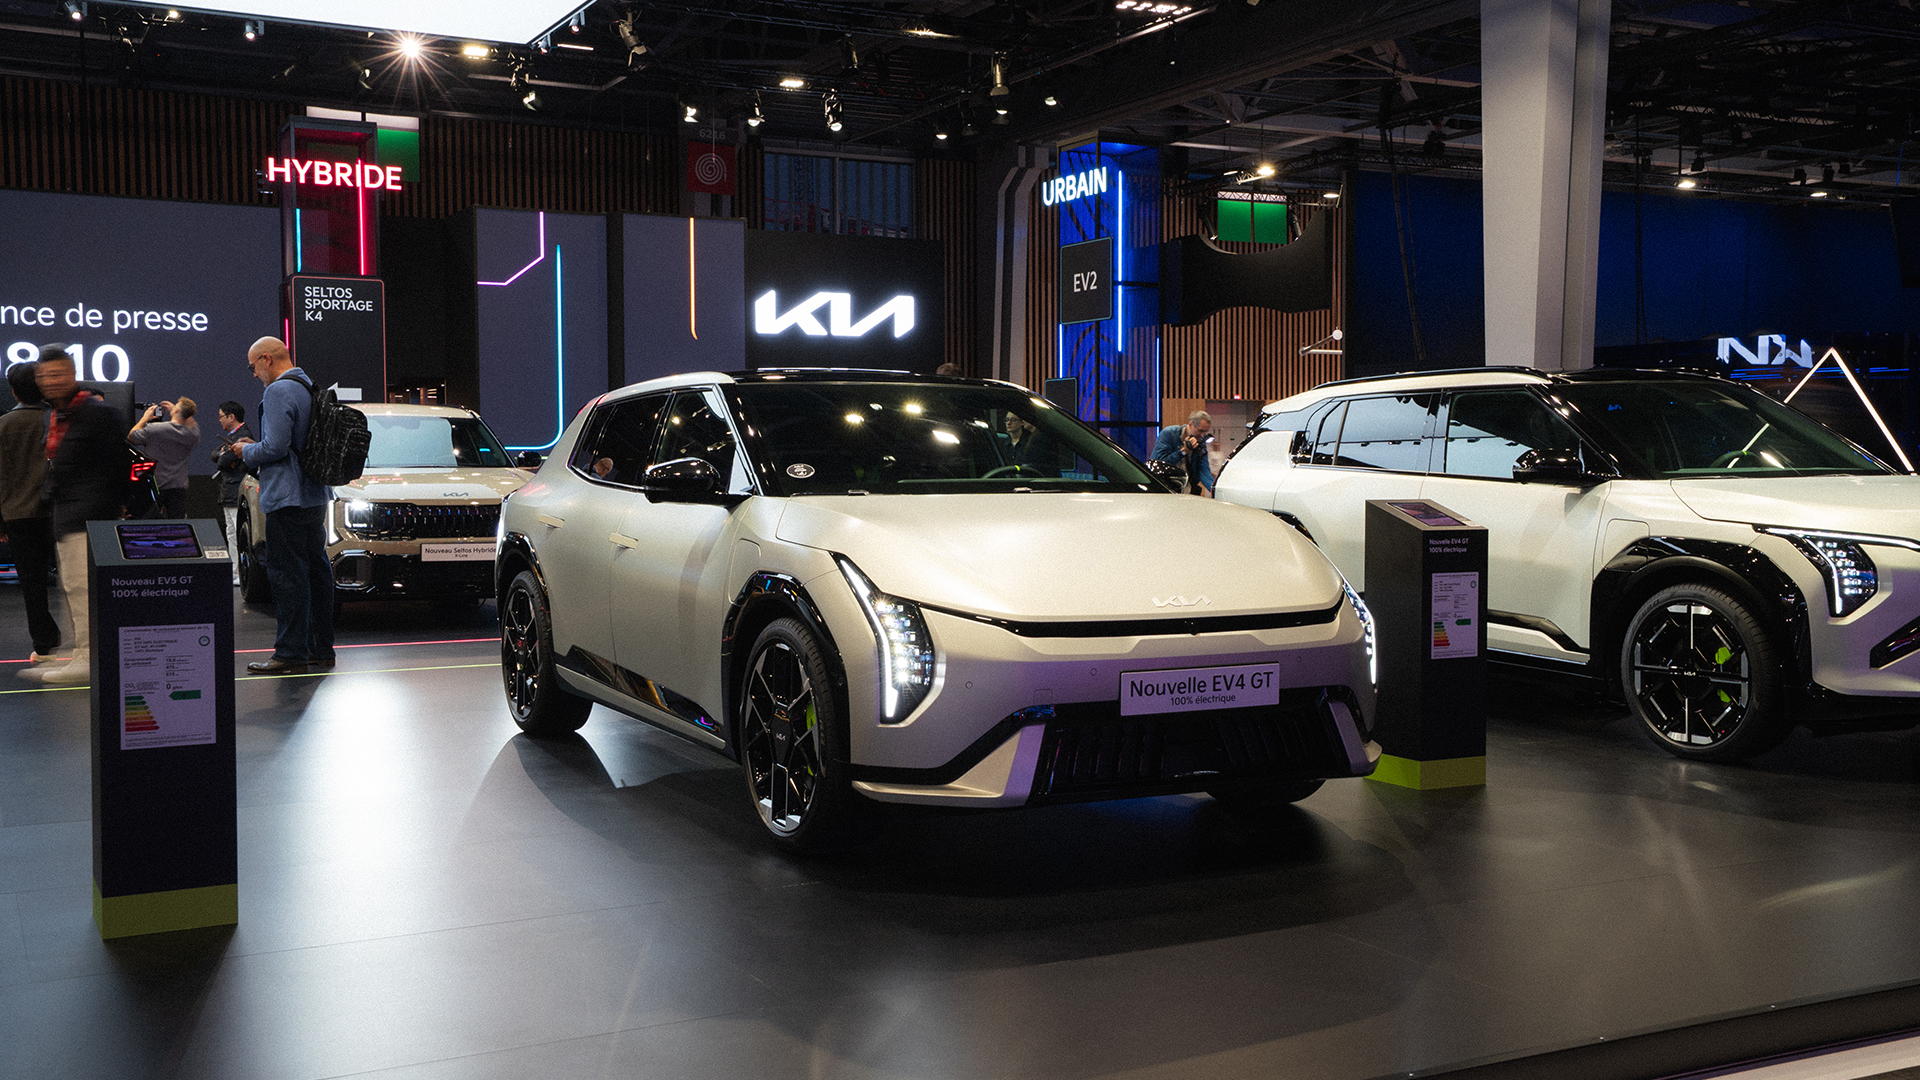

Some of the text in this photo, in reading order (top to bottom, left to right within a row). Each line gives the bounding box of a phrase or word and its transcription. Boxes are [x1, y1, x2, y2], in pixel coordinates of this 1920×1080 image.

[267, 157, 402, 190] HYBRIDE
[1042, 166, 1107, 207] URBAIN
[1073, 270, 1098, 293] EV2
[304, 286, 353, 299] SELTOS
[304, 299, 373, 311] SPORTAGE
[65, 302, 103, 328] de
[113, 308, 209, 334] presse
[305, 311, 323, 322] K4
[111, 575, 193, 587] Nouveau EV5 GT
[111, 587, 189, 598] 100% électrique
[1130, 671, 1273, 697] Nouvelle EV4 GT
[1170, 694, 1236, 706] 100% électrique
